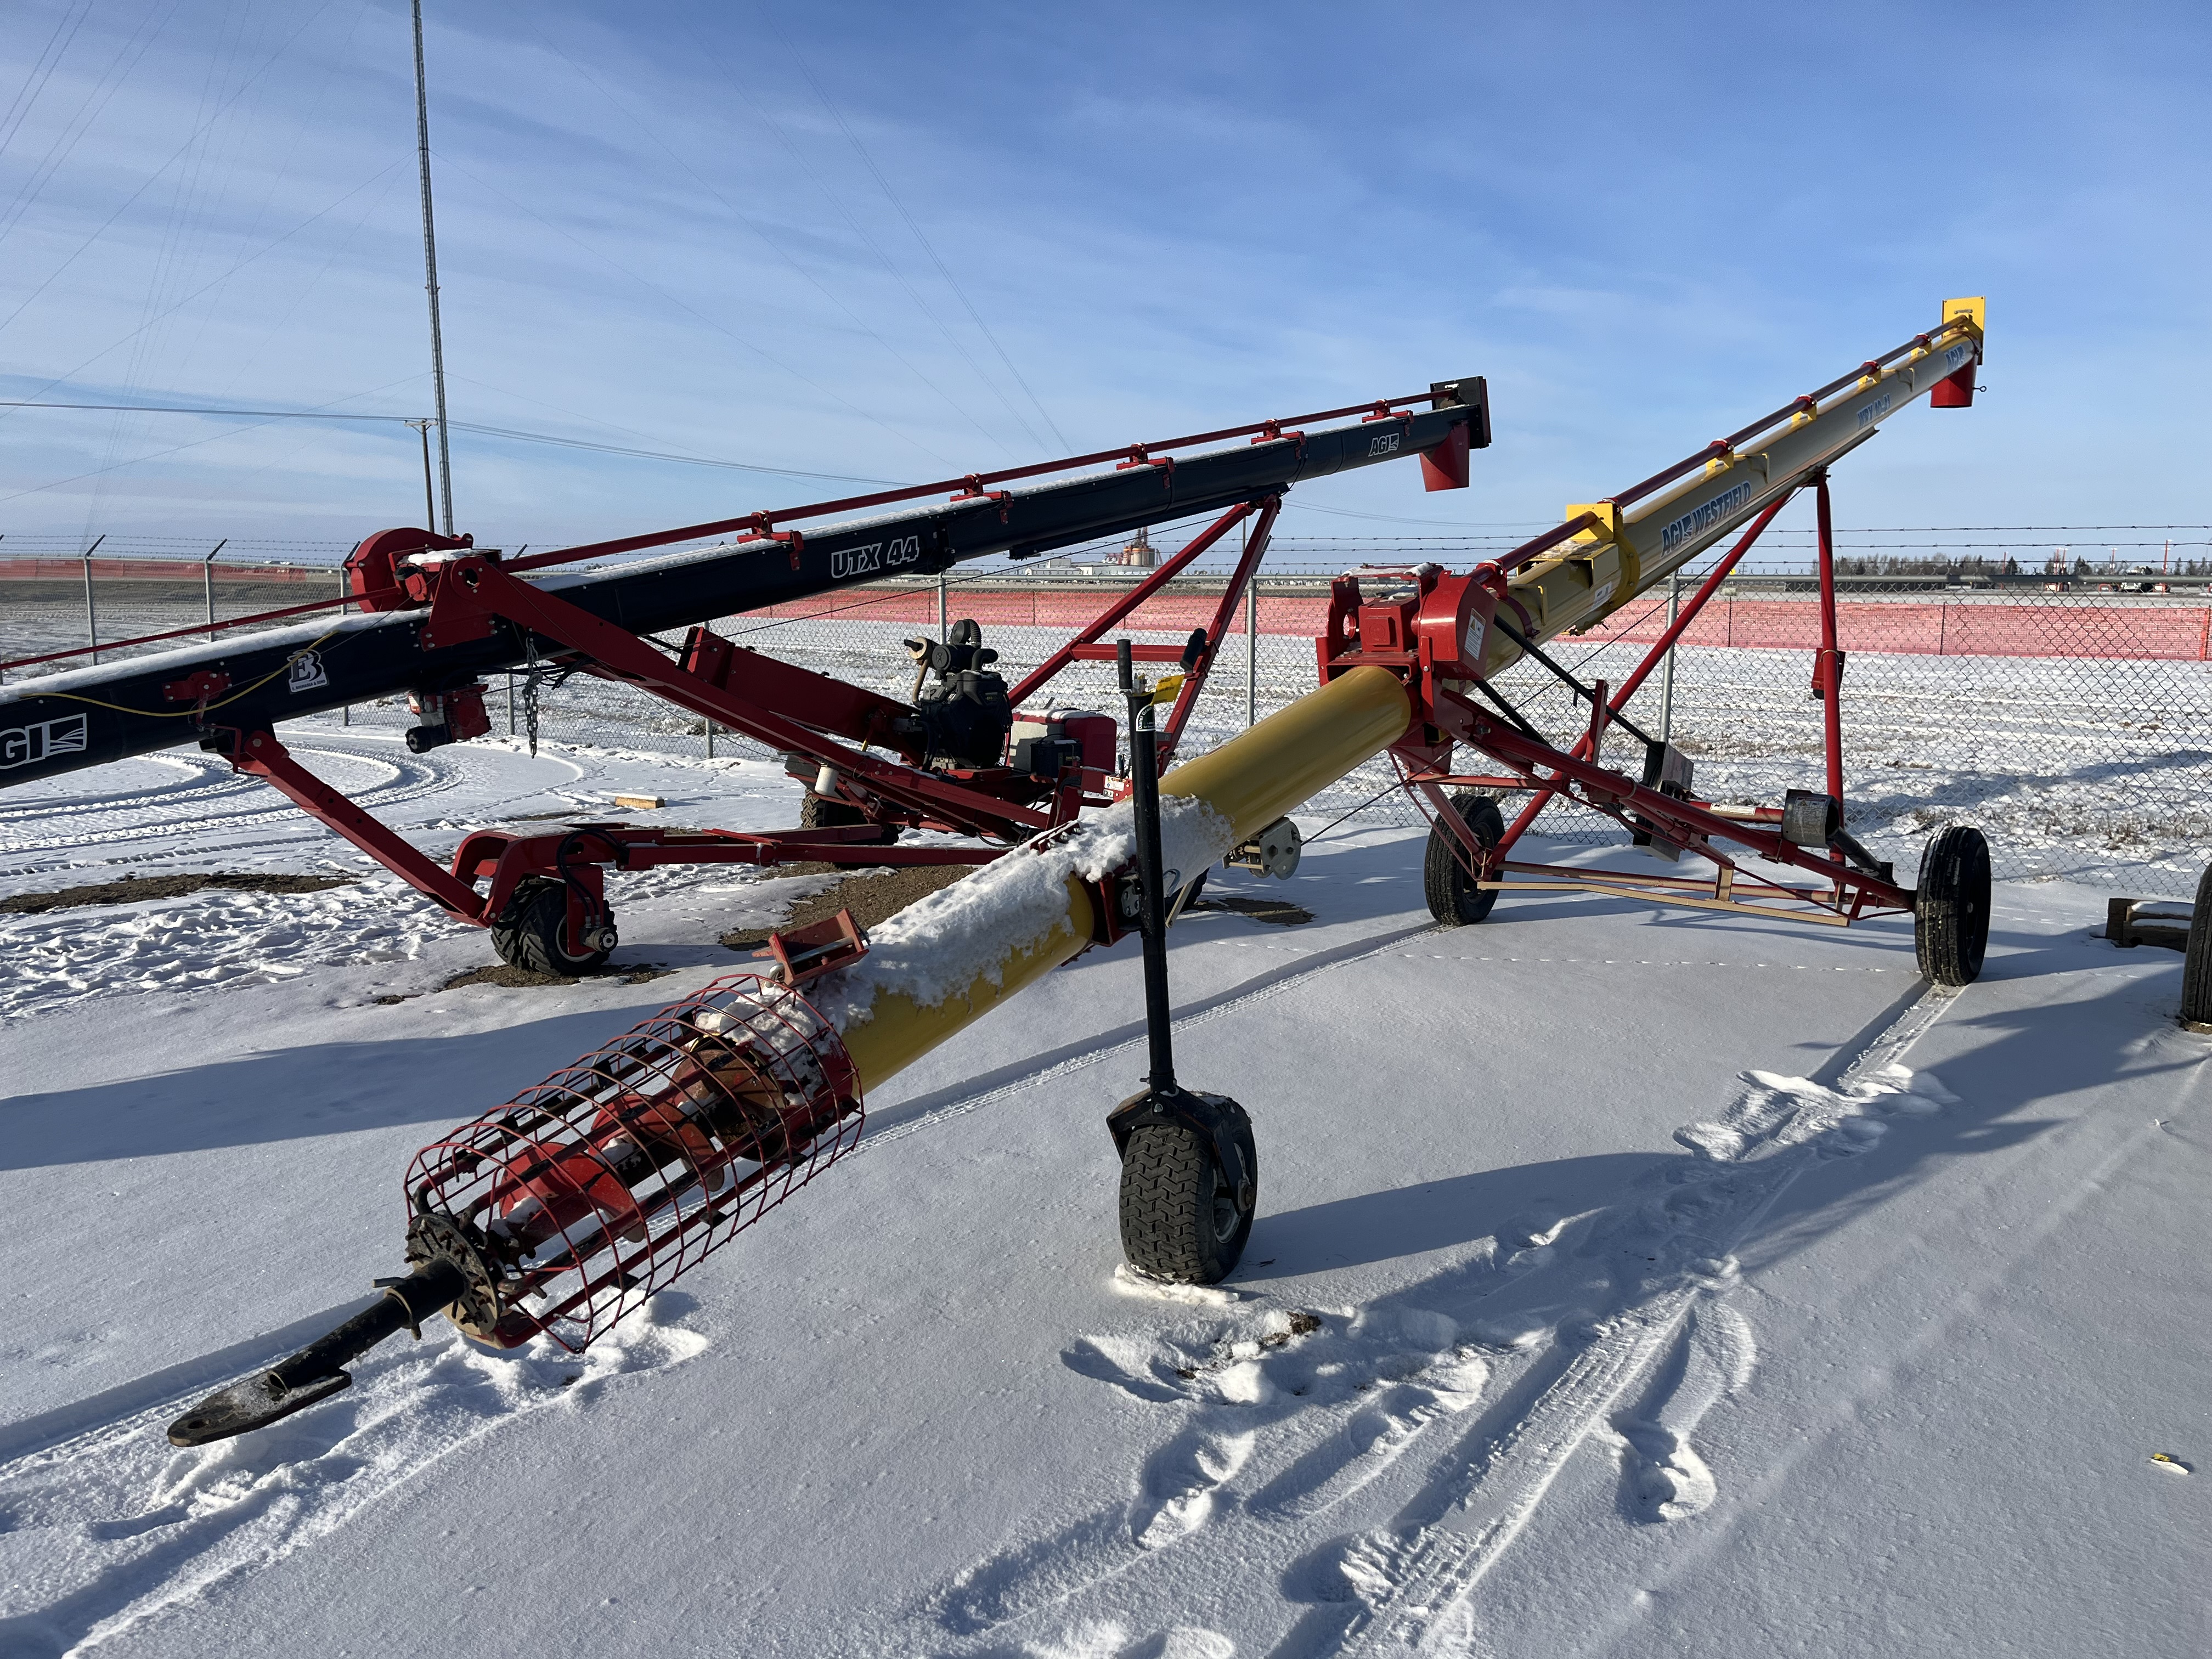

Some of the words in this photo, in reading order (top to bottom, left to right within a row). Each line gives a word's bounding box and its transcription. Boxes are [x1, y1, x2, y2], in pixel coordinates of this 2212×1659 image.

[1368, 434, 1391, 457] AGI
[1660, 522, 1683, 557] AGI
[1692, 481, 1751, 533] WESTFIELD
[831, 542, 882, 579] UTX
[887, 535, 919, 566] 44
